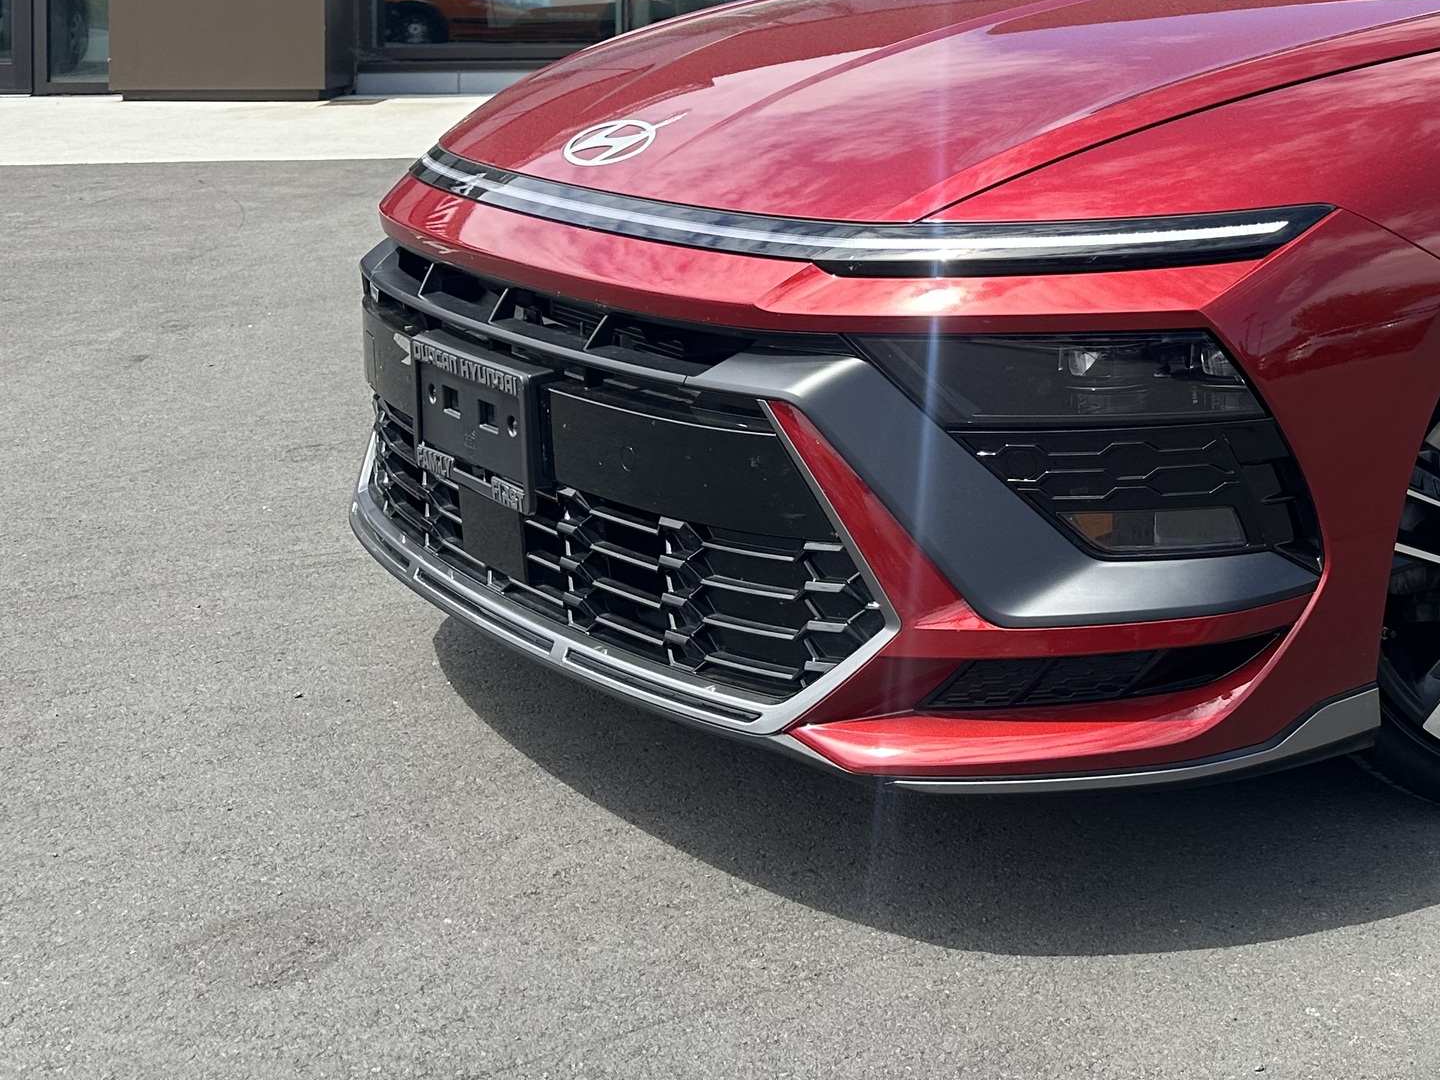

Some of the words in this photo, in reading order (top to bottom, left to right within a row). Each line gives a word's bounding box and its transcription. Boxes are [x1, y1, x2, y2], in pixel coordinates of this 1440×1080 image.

[412, 340, 458, 375] DUNCAN
[460, 359, 518, 396] HYUNDAI
[417, 446, 452, 479] FAMILY
[491, 478, 525, 513] FIRST
